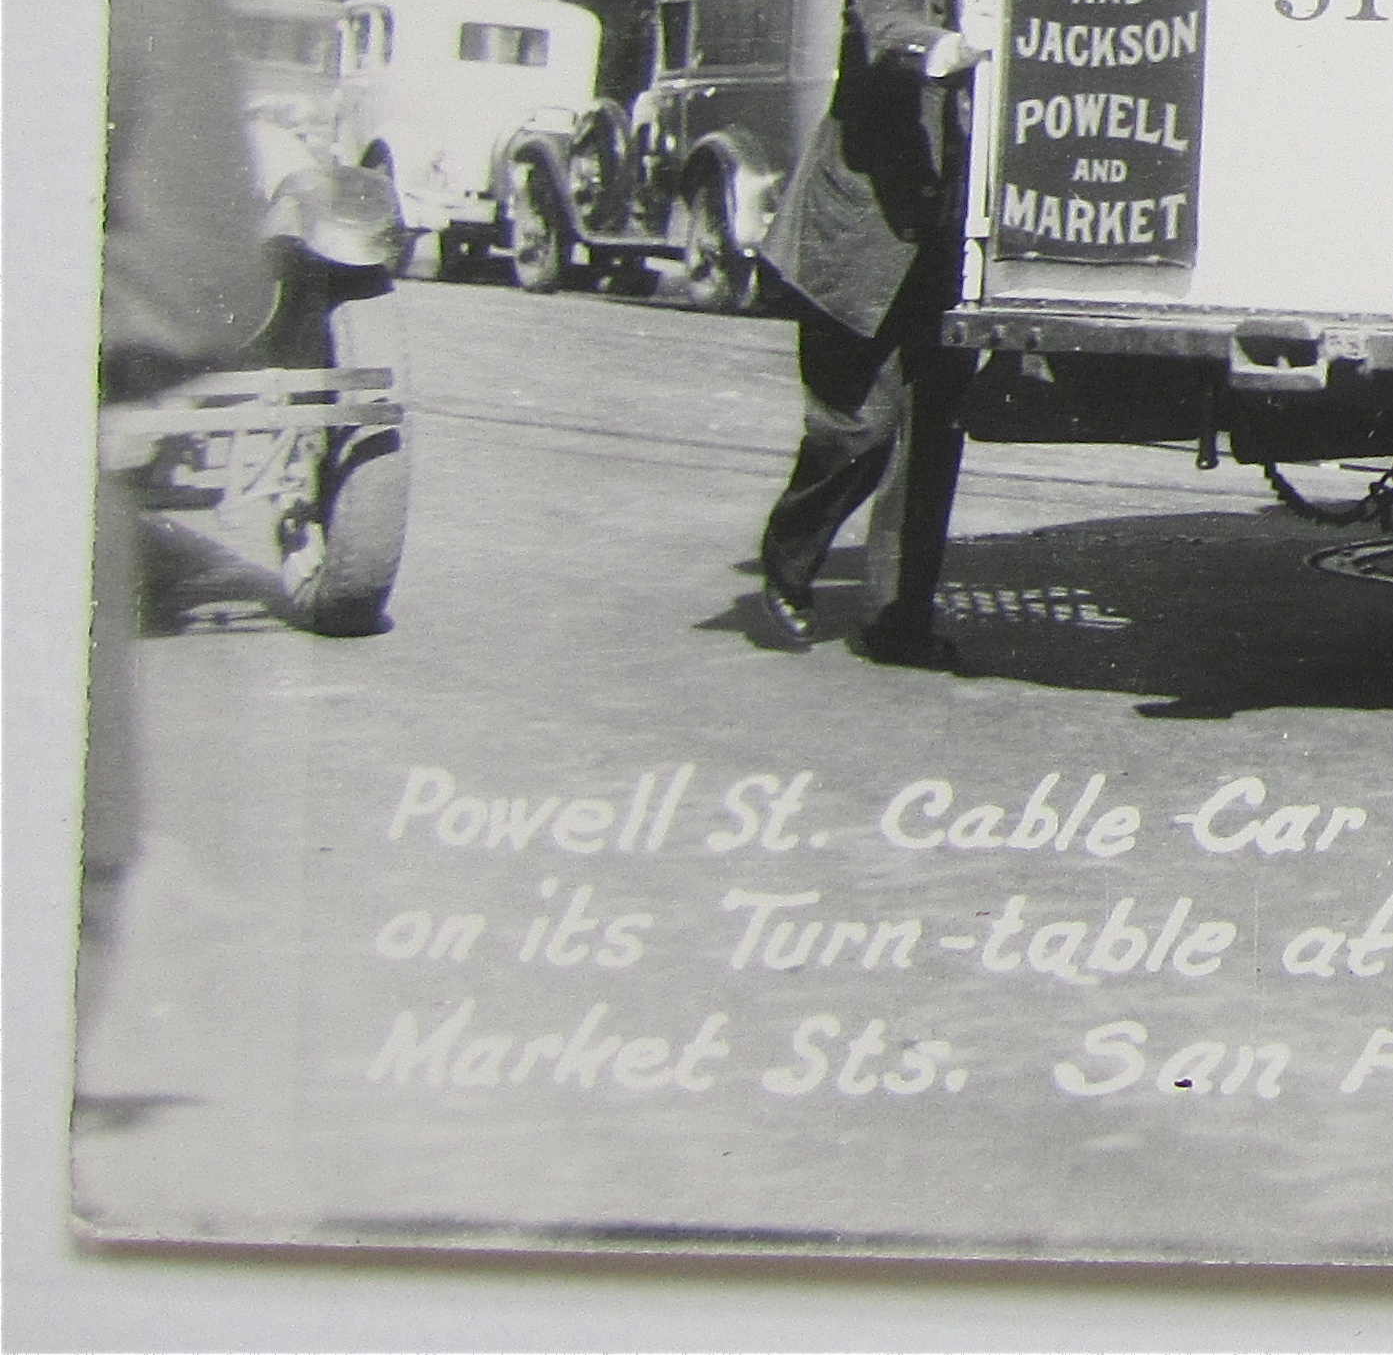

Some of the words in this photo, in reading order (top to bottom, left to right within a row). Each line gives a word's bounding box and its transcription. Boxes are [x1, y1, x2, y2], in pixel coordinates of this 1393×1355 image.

[1014, 10, 1199, 69] JACKSON
[1014, 92, 1190, 152] POWELL
[1071, 158, 1128, 183] AND
[1002, 184, 1189, 246] MARKET
